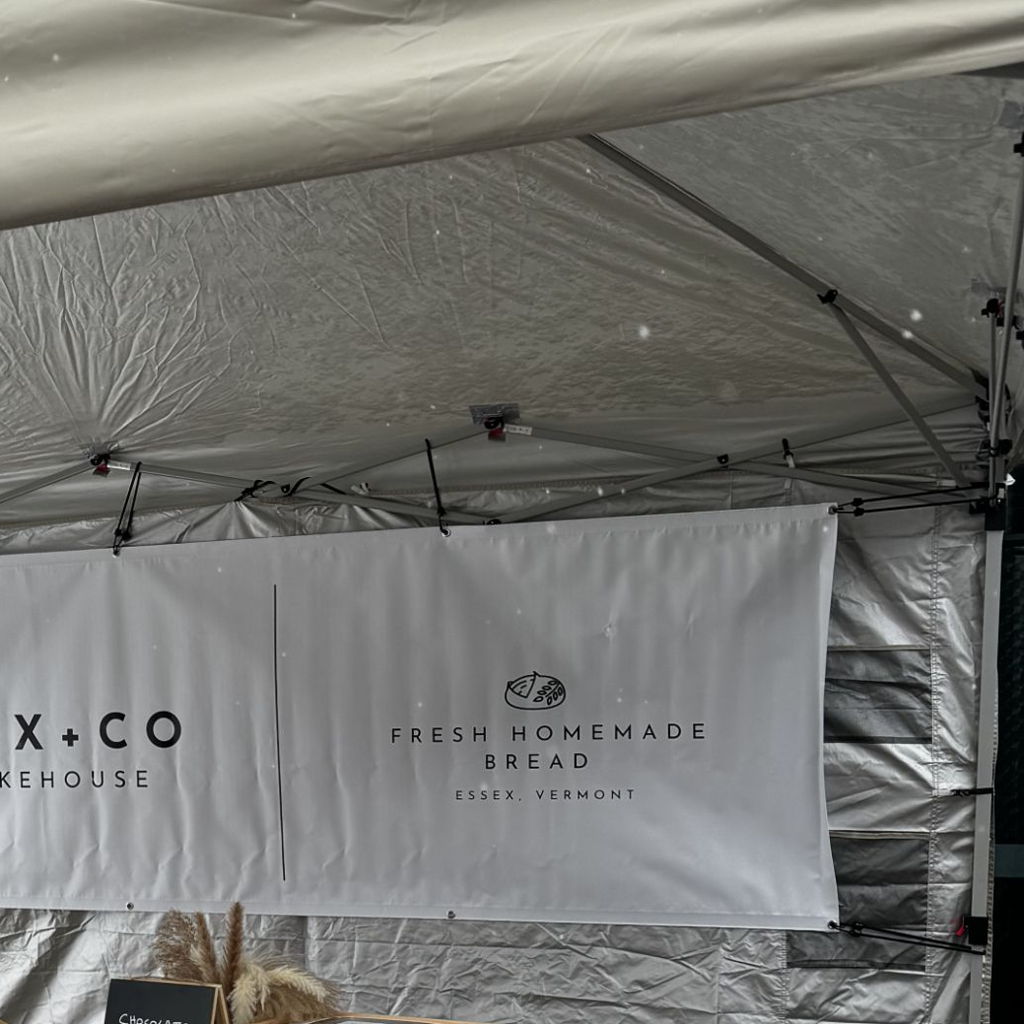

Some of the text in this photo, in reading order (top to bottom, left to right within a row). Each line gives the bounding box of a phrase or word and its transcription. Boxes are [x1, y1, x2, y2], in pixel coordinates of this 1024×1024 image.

[392, 723, 705, 743] FRESH HOMEMADE
[485, 753, 588, 770] BREAD
[456, 789, 635, 801] ESSEX, VERMONT
